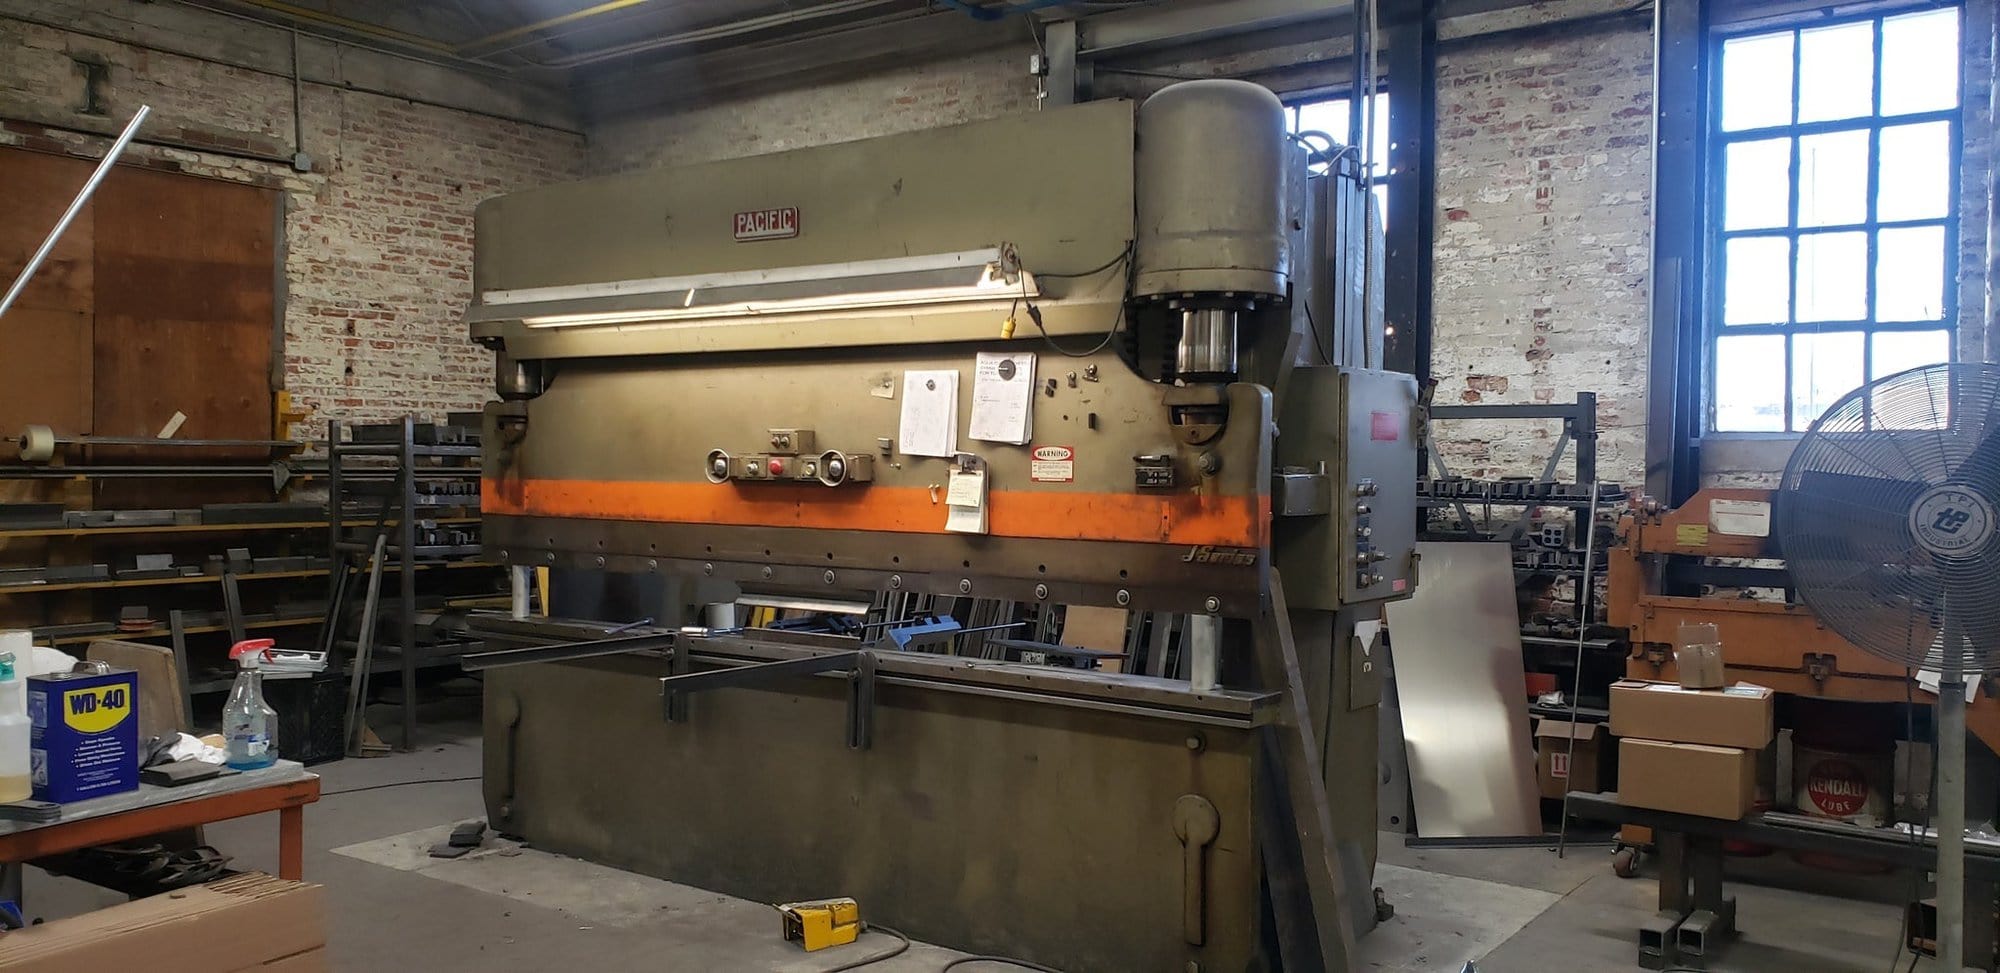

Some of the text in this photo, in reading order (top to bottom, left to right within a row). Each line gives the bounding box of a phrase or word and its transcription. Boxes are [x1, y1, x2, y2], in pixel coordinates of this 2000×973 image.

[737, 209, 793, 235] PACIFIC
[69, 688, 125, 715] WD-40
[1810, 776, 1864, 797] KENDALL
[1821, 798, 1850, 812] LUBE
